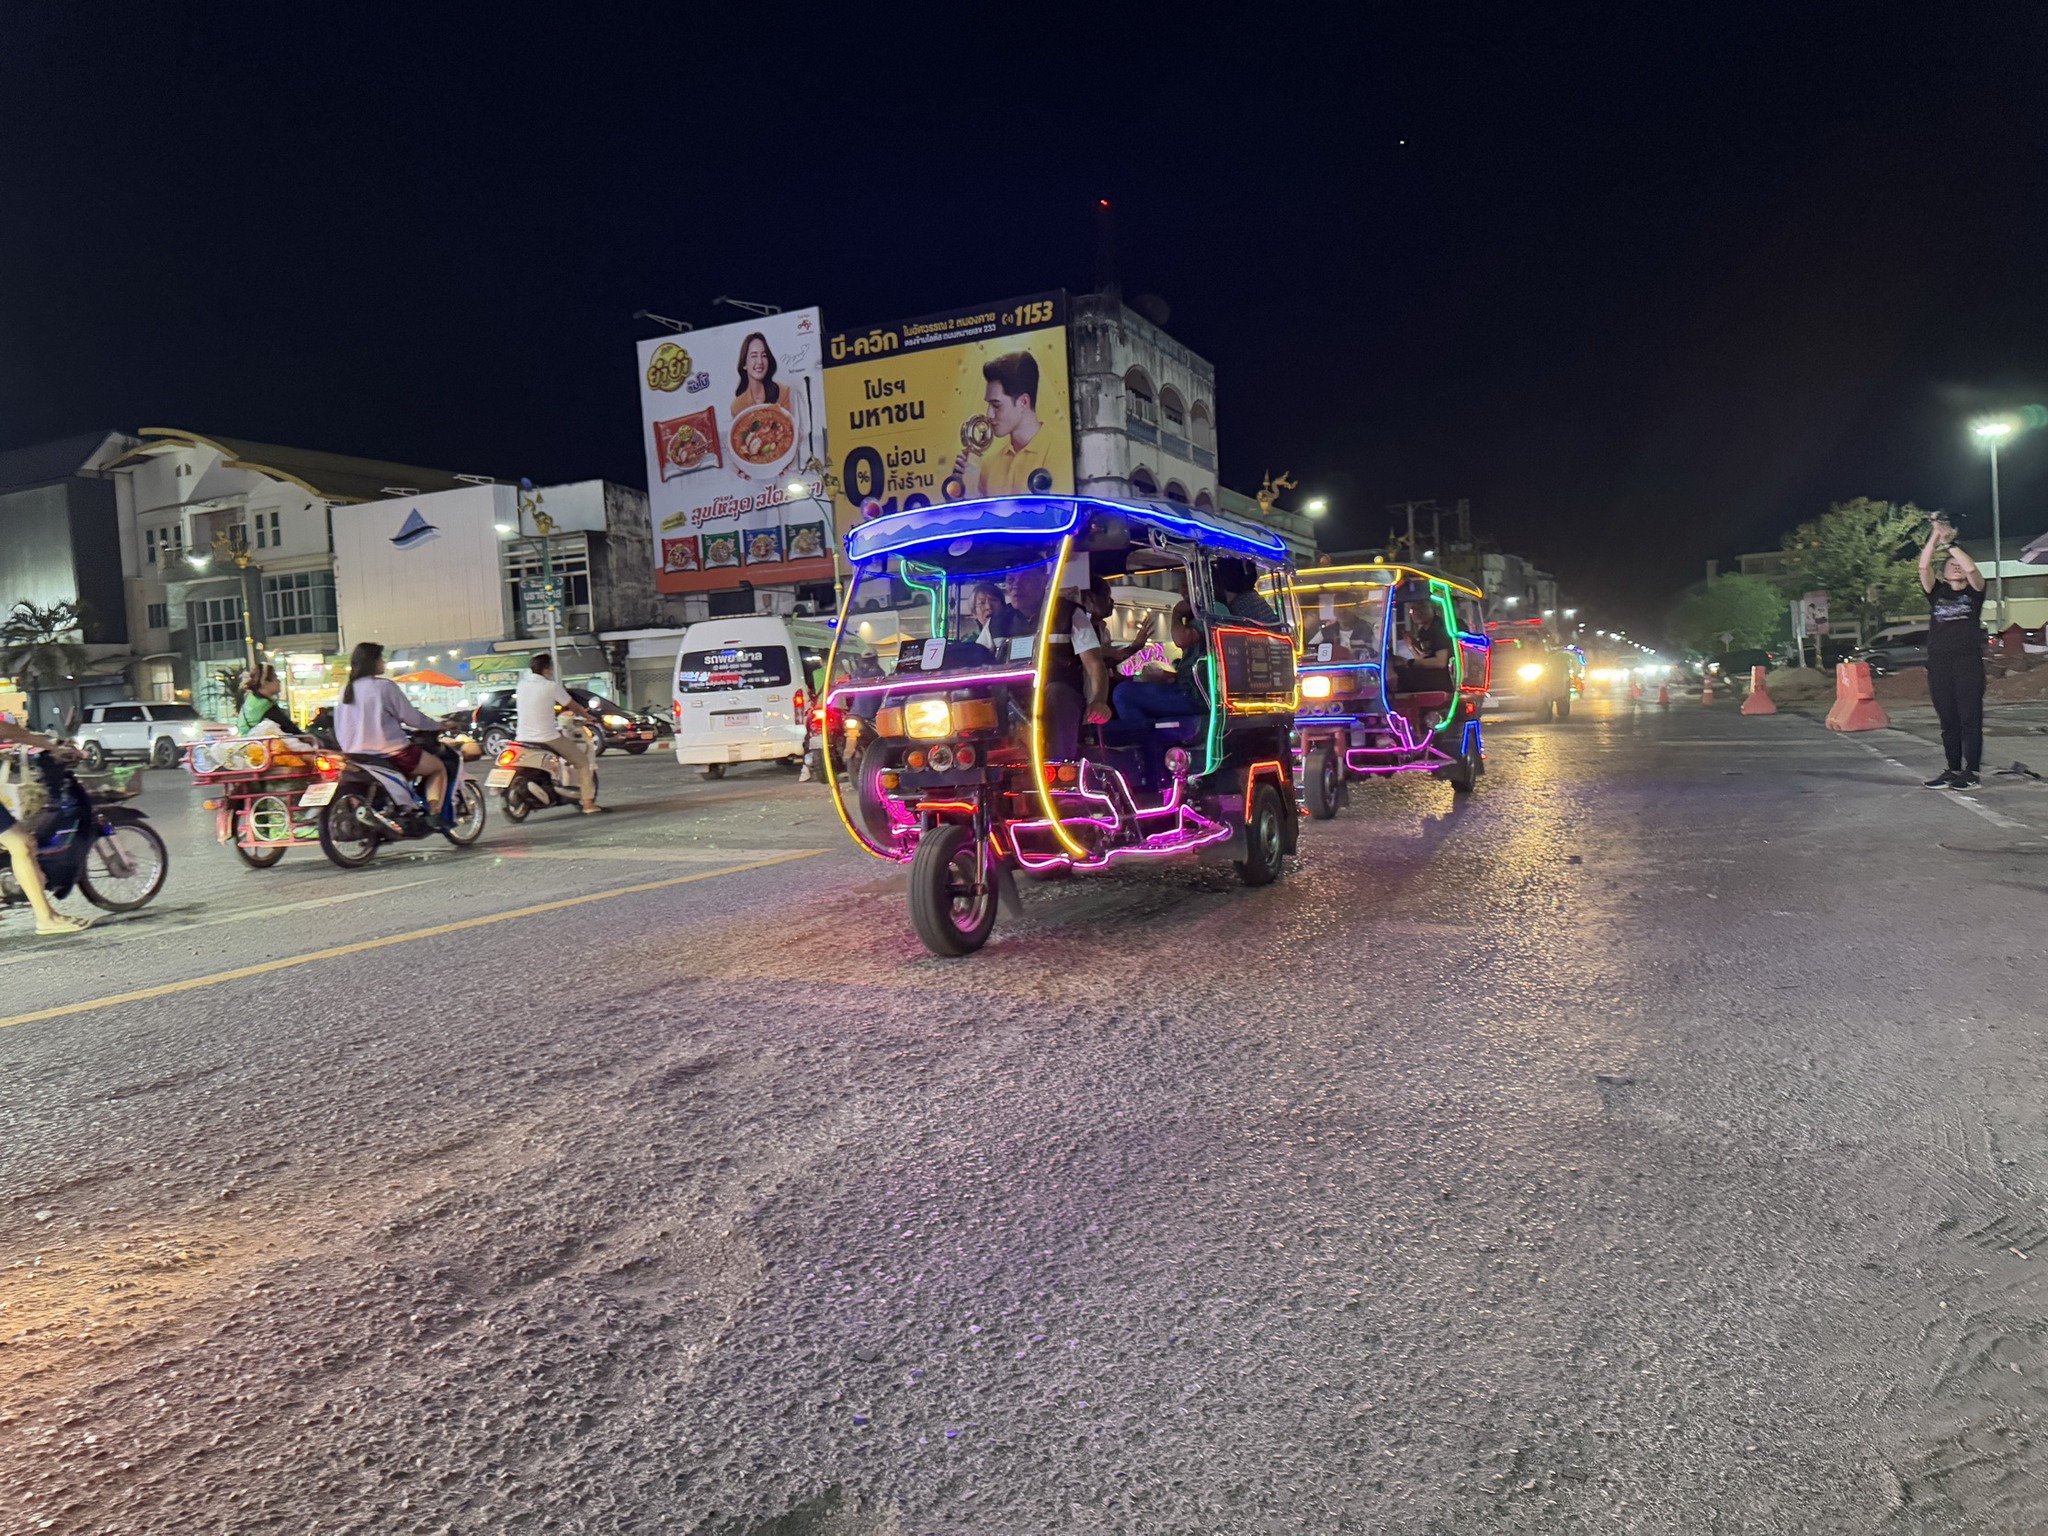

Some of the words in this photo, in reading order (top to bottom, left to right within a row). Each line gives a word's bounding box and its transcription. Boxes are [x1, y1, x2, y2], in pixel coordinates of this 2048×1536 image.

[948, 319, 955, 330] 2
[1015, 301, 1053, 326] 1153
[830, 329, 899, 360] บี-ควิก
[864, 378, 906, 400] โปรฯ
[850, 400, 925, 430] มหาชน
[886, 445, 926, 468] ผ่อน
[887, 470, 934, 491] ทั้งร้าน
[930, 648, 939, 660] 7
